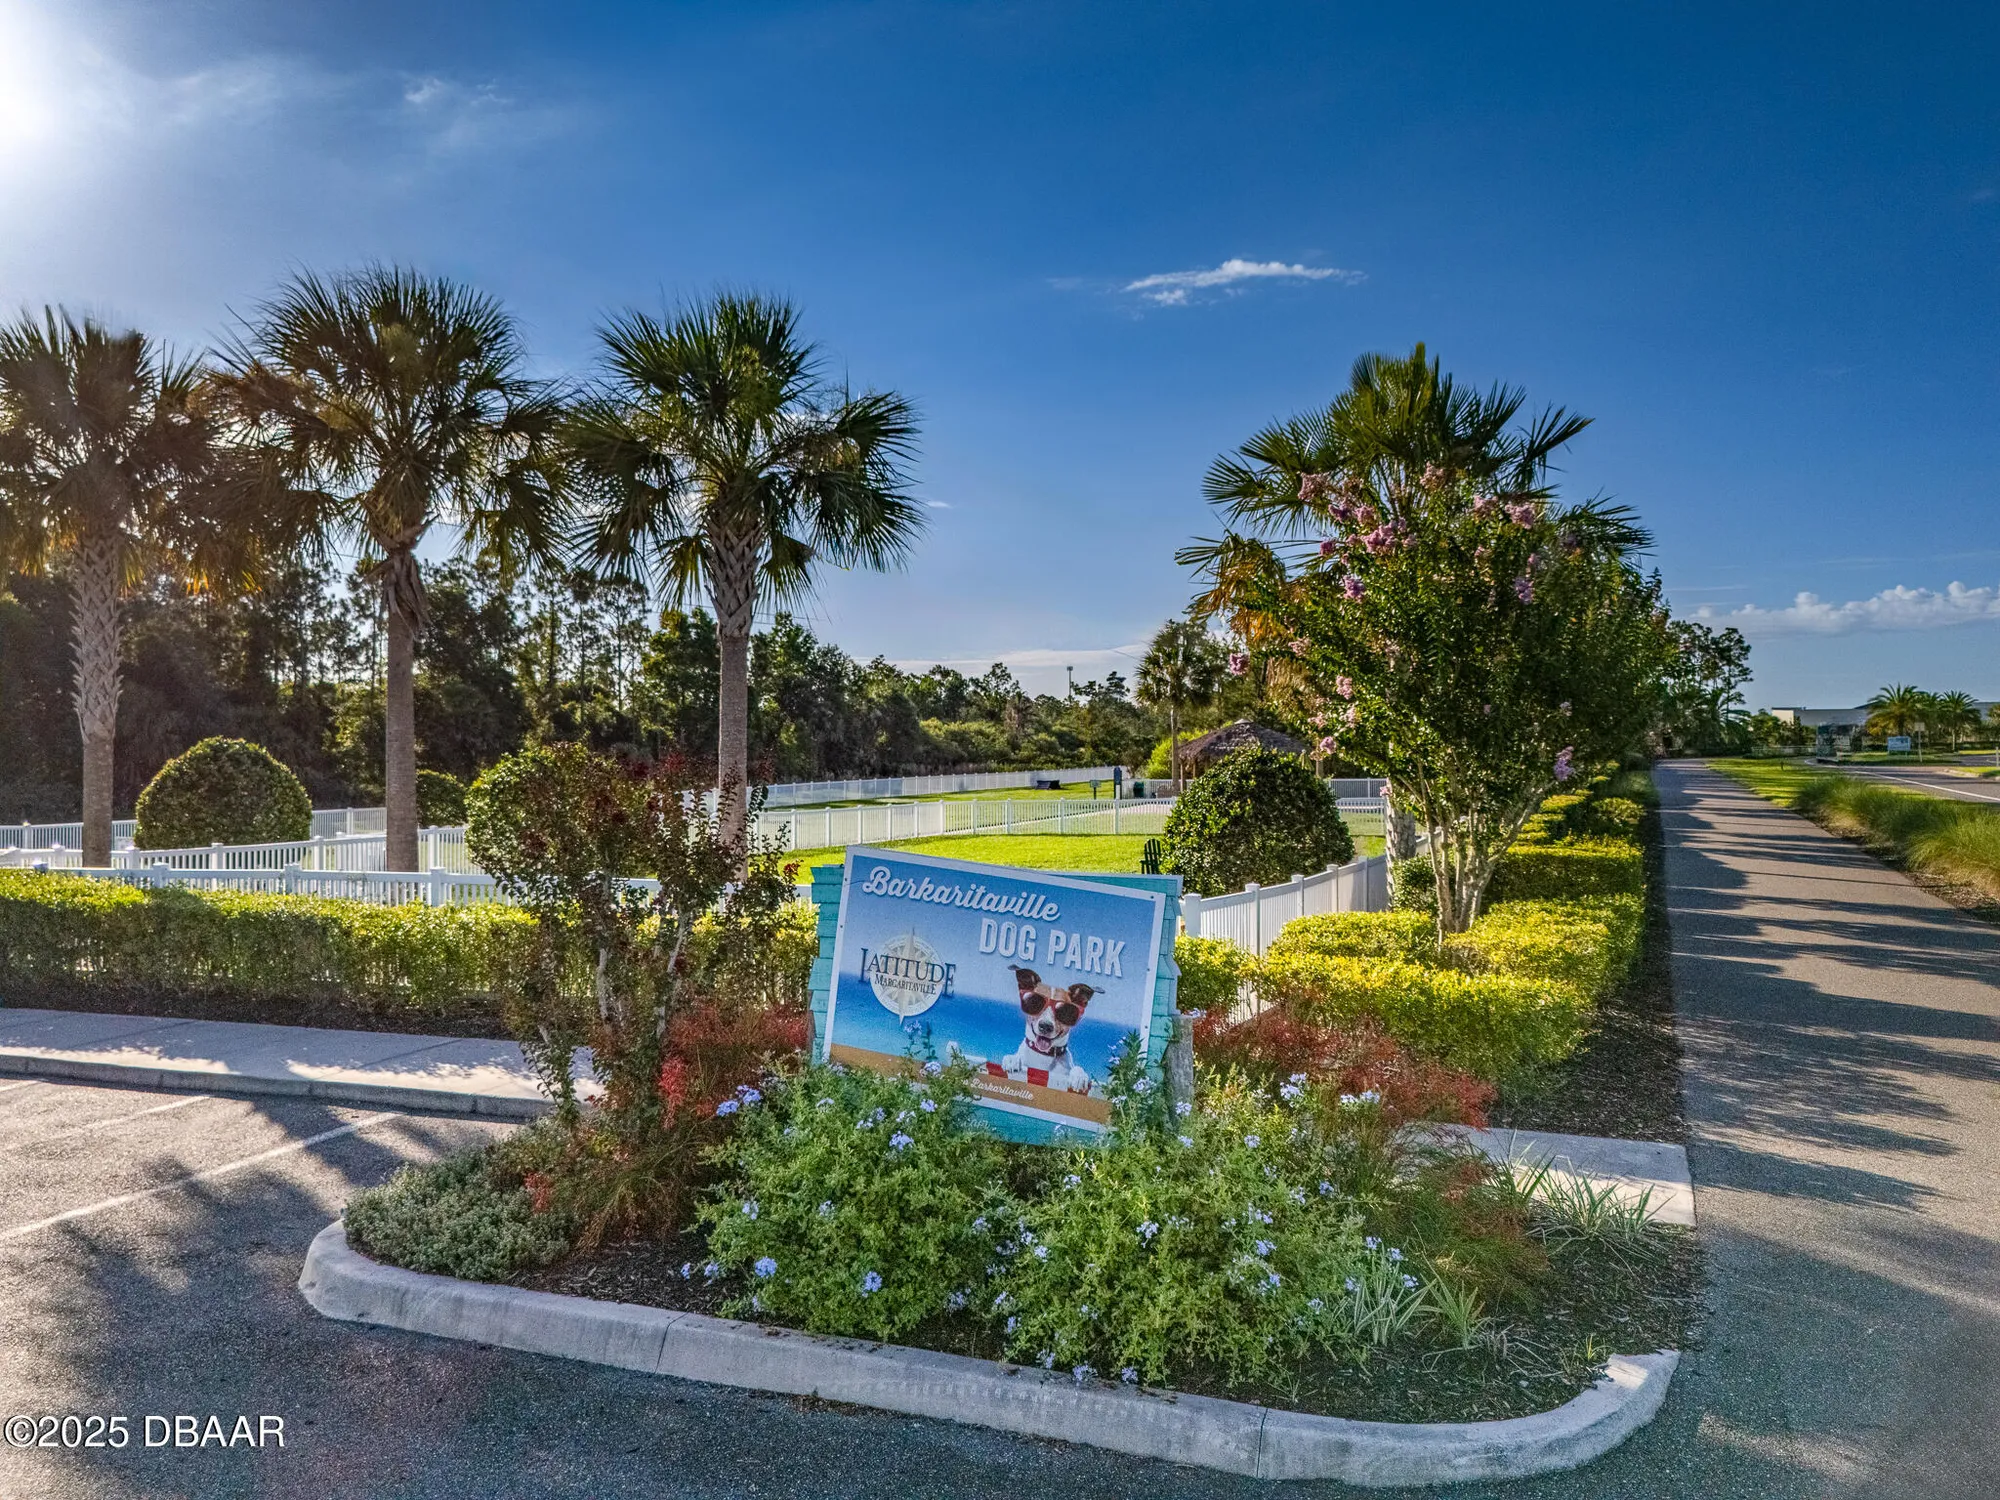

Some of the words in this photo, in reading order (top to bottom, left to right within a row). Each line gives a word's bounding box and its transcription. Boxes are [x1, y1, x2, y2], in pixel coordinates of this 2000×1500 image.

[862, 865, 1061, 922] Barkaritaville
[859, 948, 956, 998] LATITUDE
[979, 917, 1037, 961] DOG
[1047, 929, 1126, 977] PARK
